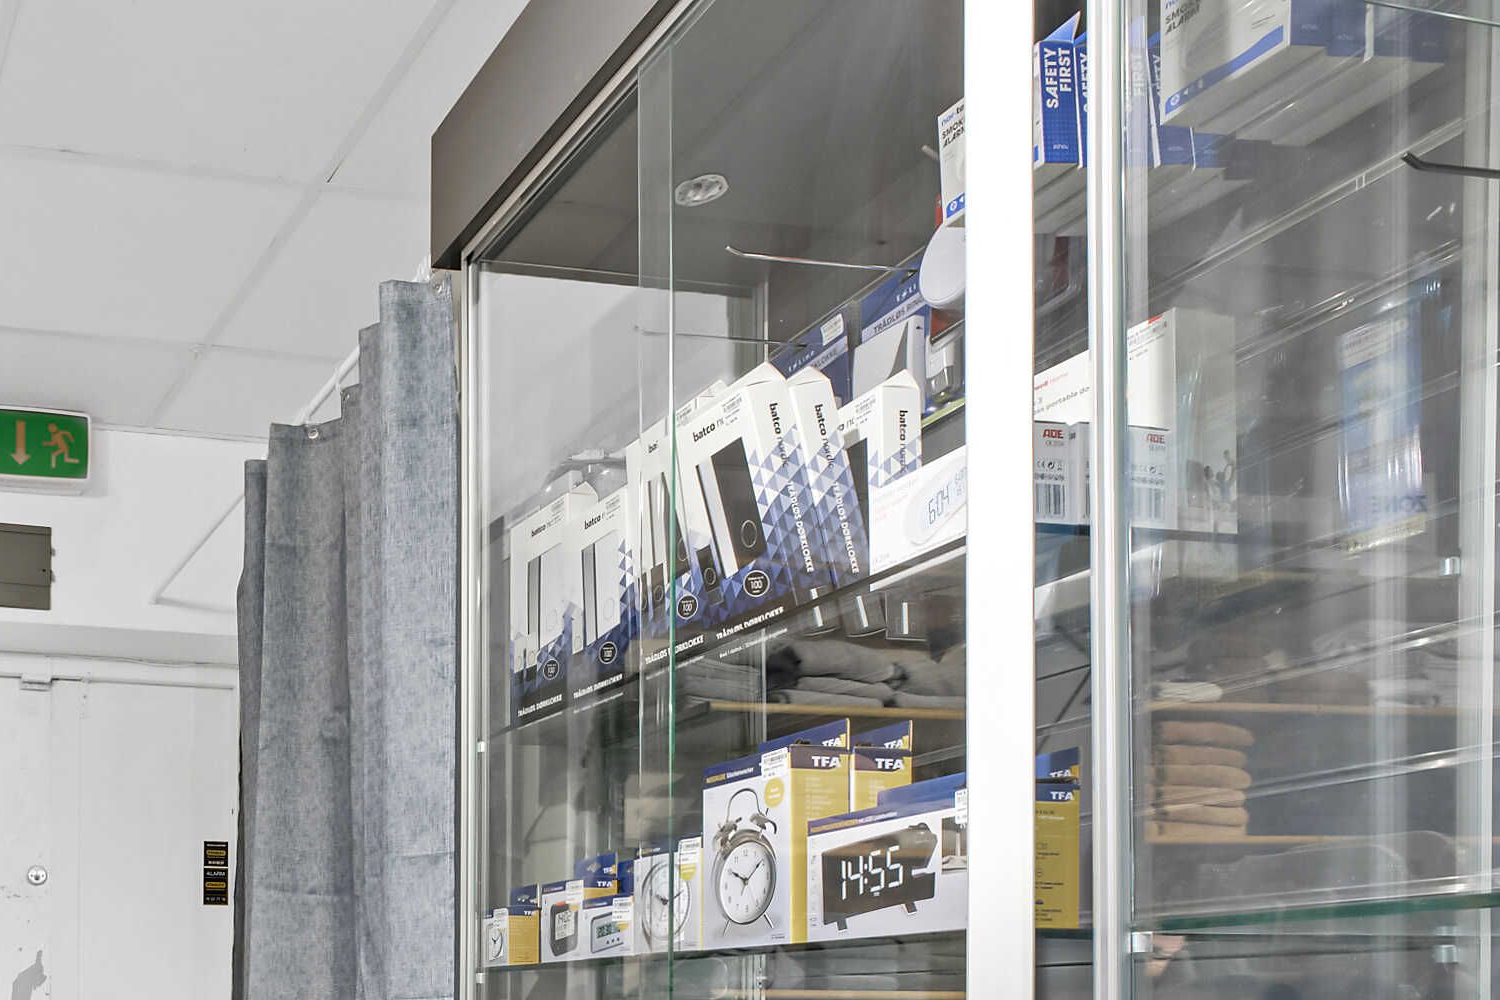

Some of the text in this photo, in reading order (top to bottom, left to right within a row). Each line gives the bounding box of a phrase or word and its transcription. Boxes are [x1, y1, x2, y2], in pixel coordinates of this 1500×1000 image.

[1044, 48, 1059, 108] SAFETY
[1059, 48, 1072, 92] FIRST
[769, 402, 782, 435] batco
[814, 404, 827, 436] batco
[899, 410, 908, 441] batco
[693, 422, 716, 443] batco
[1043, 429, 1064, 439] ADE
[584, 514, 602, 530] batco
[822, 737, 842, 747] TFA
[884, 739, 904, 748] TFA
[812, 756, 842, 768] TFA
[875, 758, 905, 770] TFA
[1050, 770, 1072, 778] TFA
[1050, 792, 1076, 800] TFA
[841, 845, 904, 901] 14:55
